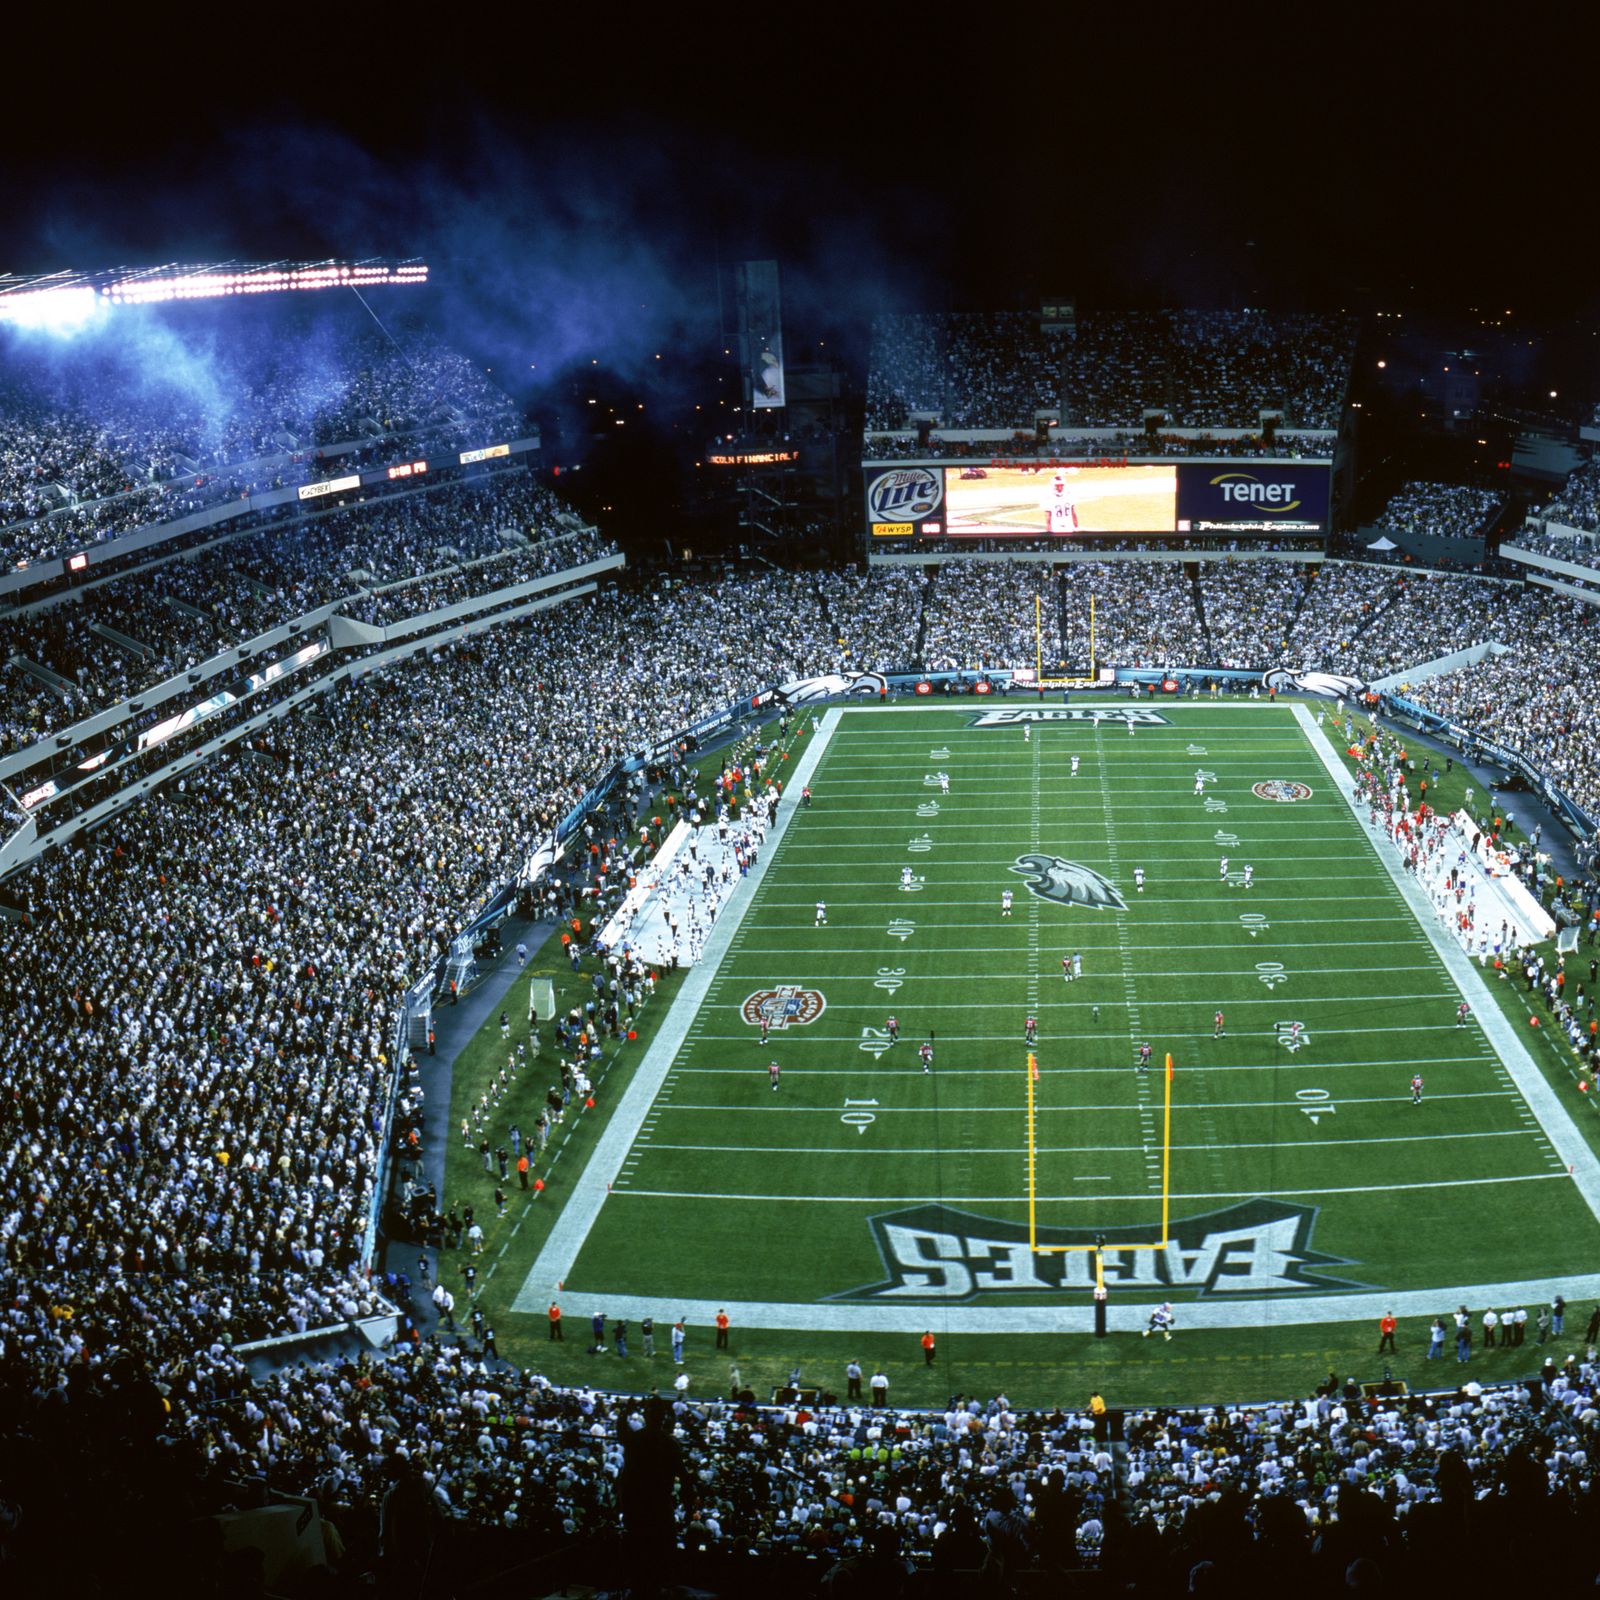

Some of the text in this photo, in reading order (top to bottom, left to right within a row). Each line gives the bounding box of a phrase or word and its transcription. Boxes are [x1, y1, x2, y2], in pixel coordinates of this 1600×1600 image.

[737, 453, 791, 463] FINANCIAL
[889, 472, 931, 487] Miller
[877, 480, 938, 513] Lite
[1199, 521, 1320, 531] PhiladelphiaEagles.com
[974, 709, 1167, 726] EAGLES
[1499, 747, 1518, 763] YOUTH
[916, 803, 940, 817] 30
[1203, 800, 1228, 813] 30
[907, 837, 933, 852] 40
[1214, 834, 1240, 848] 40
[887, 918, 916, 936] 40
[1239, 913, 1270, 932] 40
[874, 967, 907, 989] 30
[1255, 962, 1288, 983] 30
[1296, 1088, 1336, 1115] 10
[840, 1098, 880, 1125] 10
[872, 1213, 1321, 1297] EAGLES
